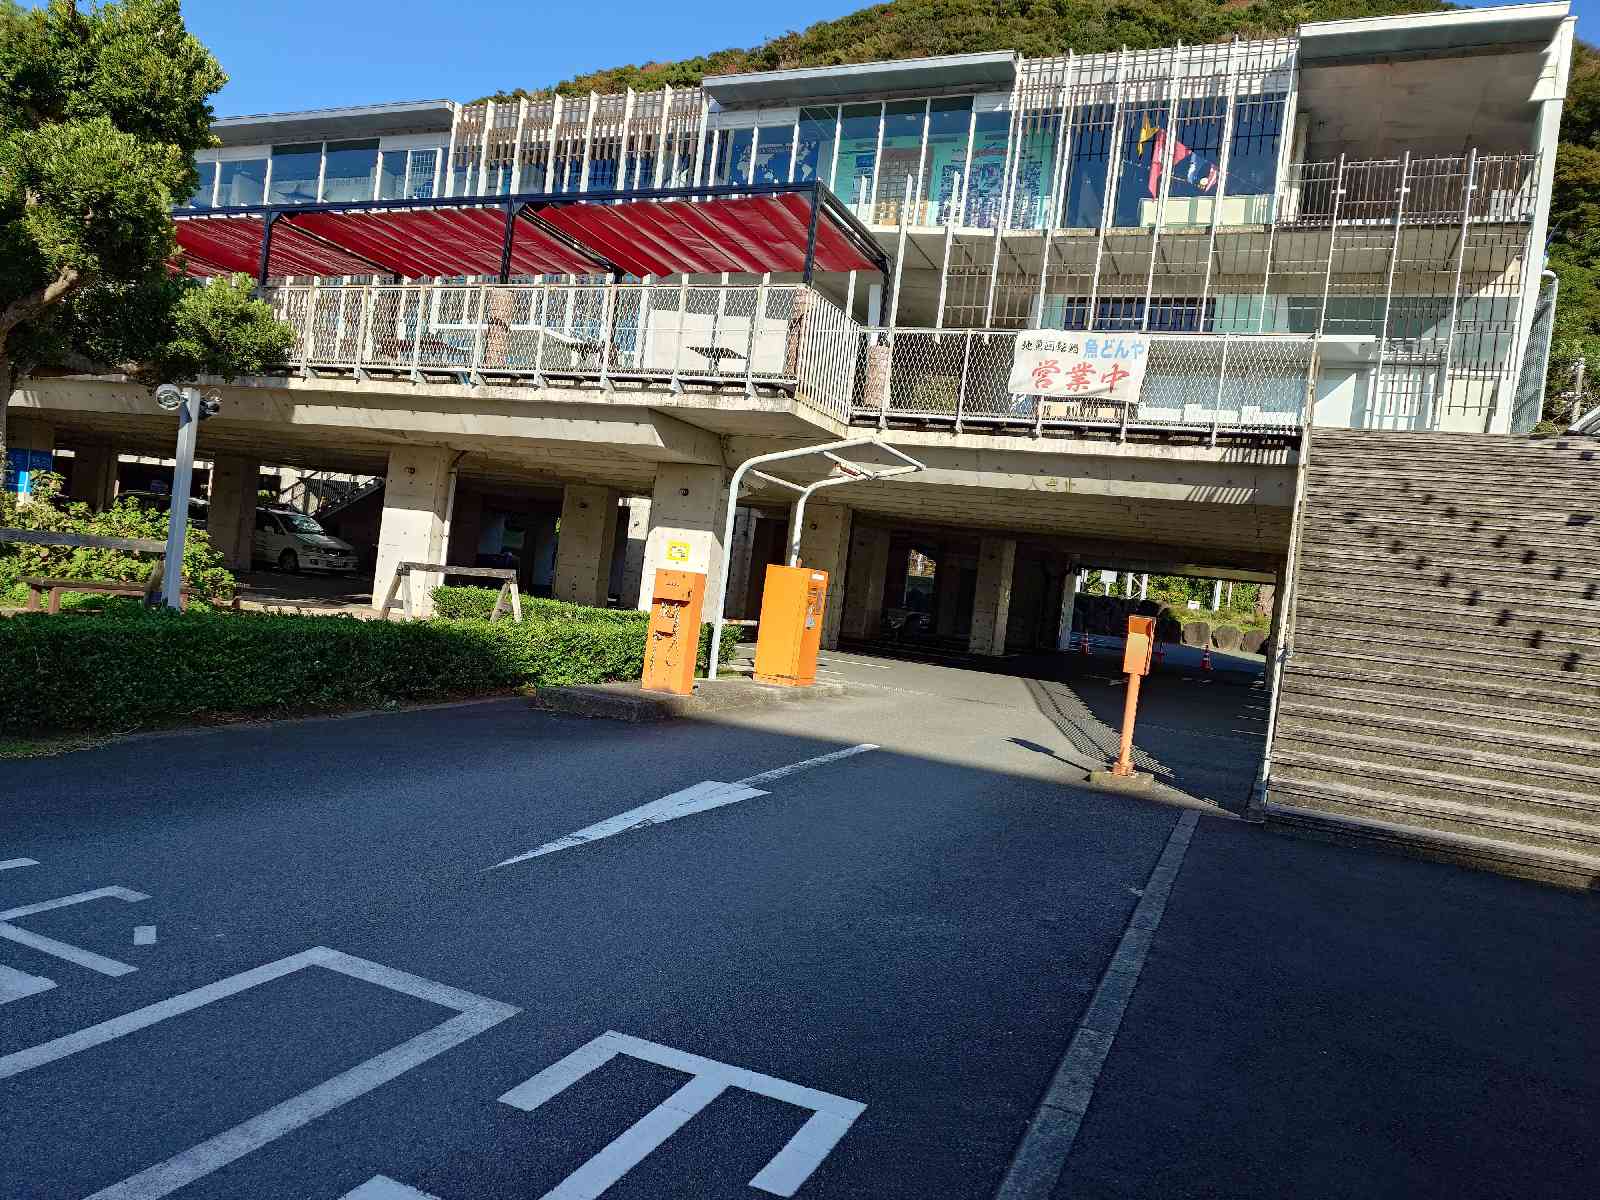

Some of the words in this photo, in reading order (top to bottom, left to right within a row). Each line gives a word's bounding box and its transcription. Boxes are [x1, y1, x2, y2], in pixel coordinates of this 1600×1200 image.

[1082, 338, 1145, 360] 魚どんや
[1032, 360, 1130, 393] 営業中
